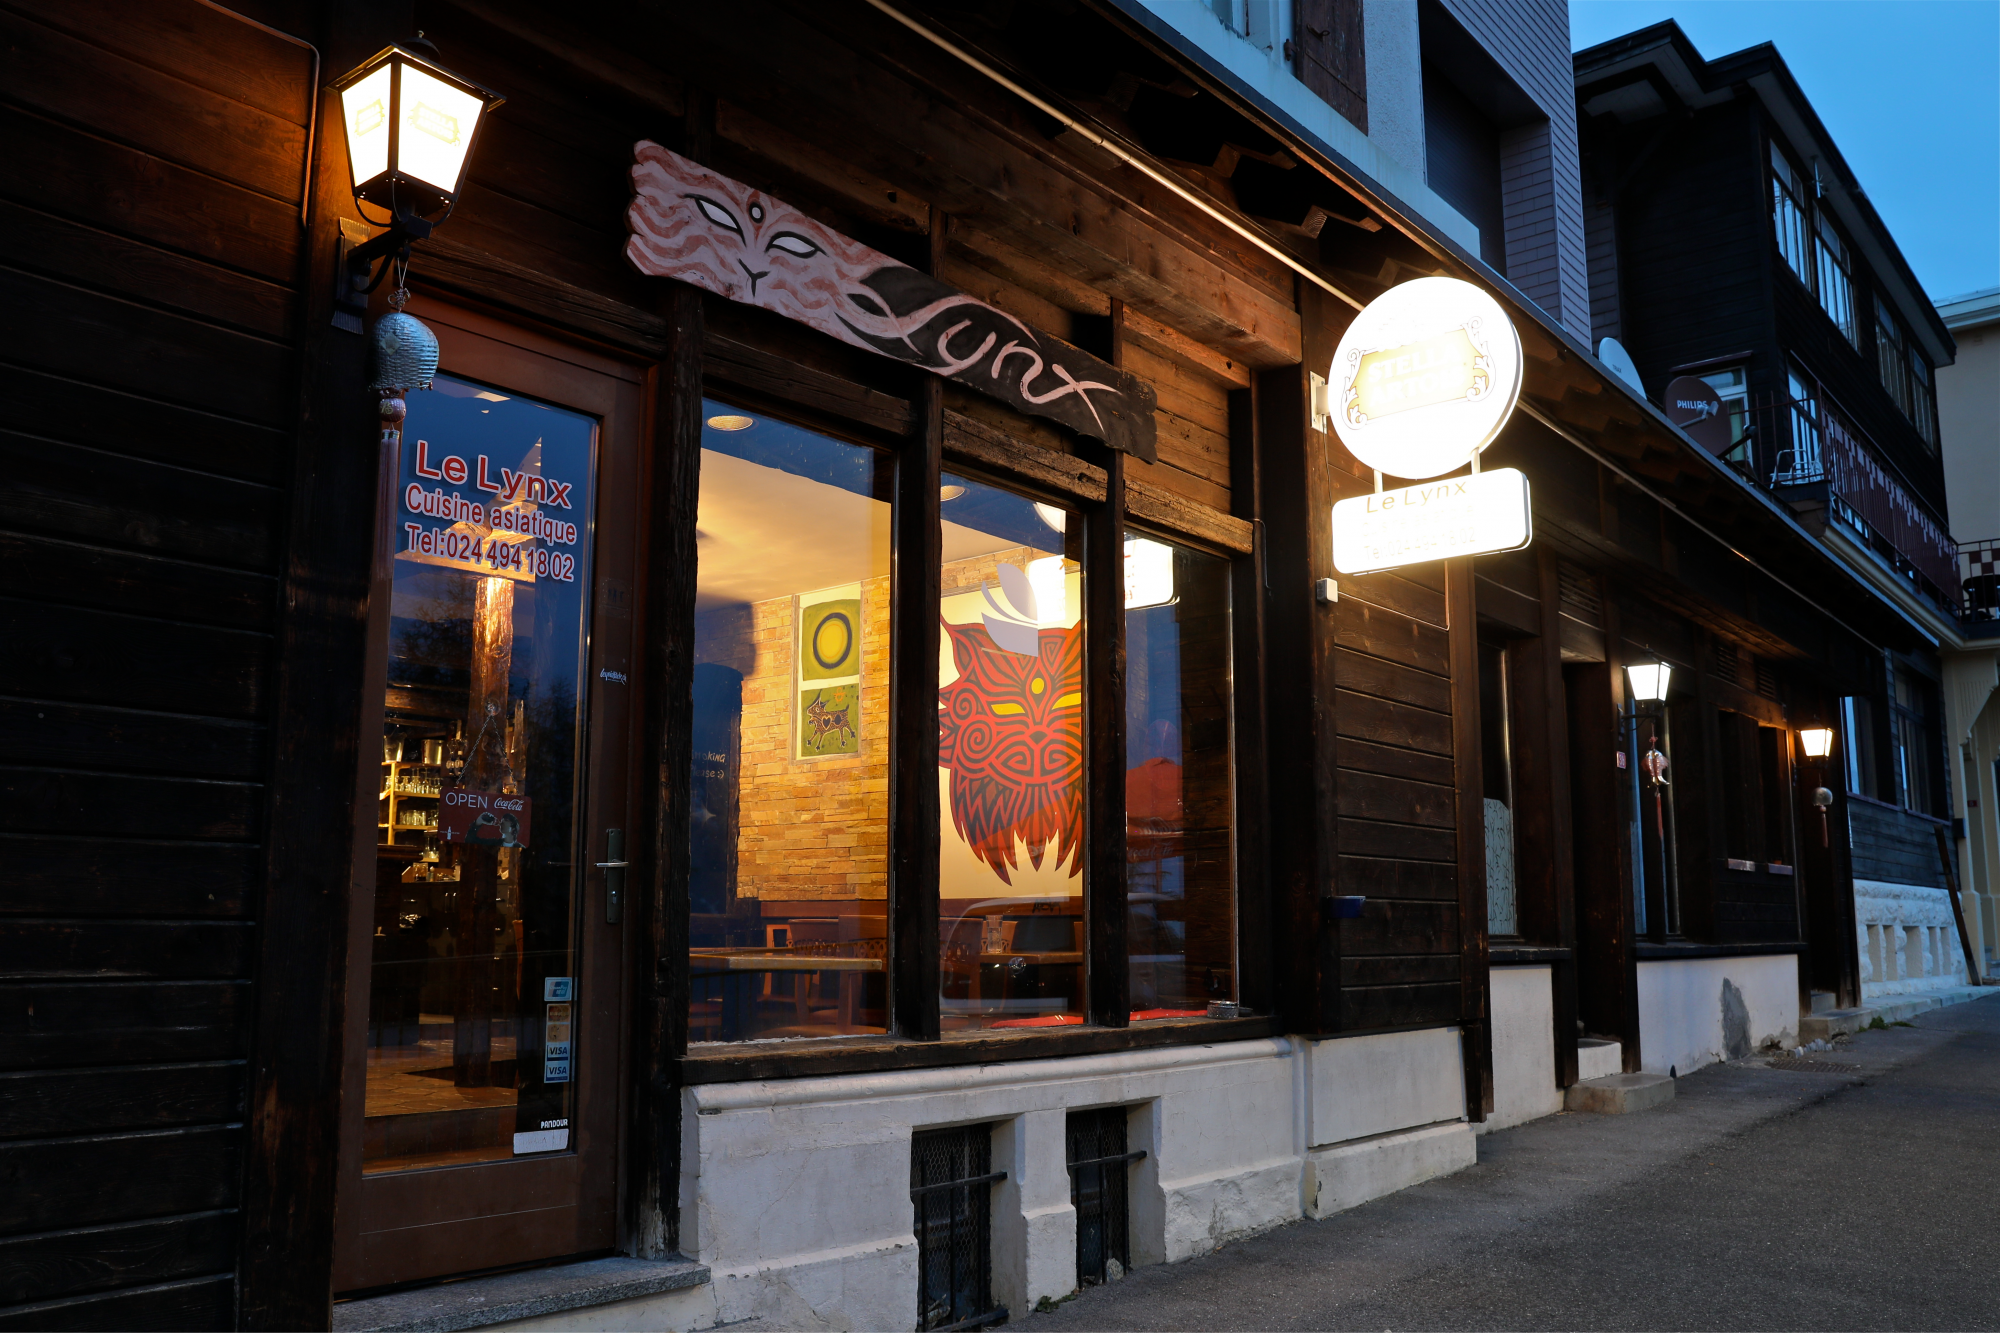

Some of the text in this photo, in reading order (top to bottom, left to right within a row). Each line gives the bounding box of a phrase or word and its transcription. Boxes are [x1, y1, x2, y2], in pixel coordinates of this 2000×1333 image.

[838, 274, 1122, 433] Lynx
[1367, 342, 1463, 383] STELLA
[1369, 365, 1466, 407] ARTOIS
[416, 440, 572, 509] Le Lynx
[405, 483, 577, 546] Cuisine asiatique
[1365, 480, 1468, 514] Le Lynx
[405, 522, 483, 565] Tel:024
[486, 540, 522, 572] 494
[445, 792, 488, 809] OPEN
[548, 1066, 567, 1076] VISA
[549, 1046, 568, 1056] VISA
[540, 1118, 568, 1129] PANDOUR
